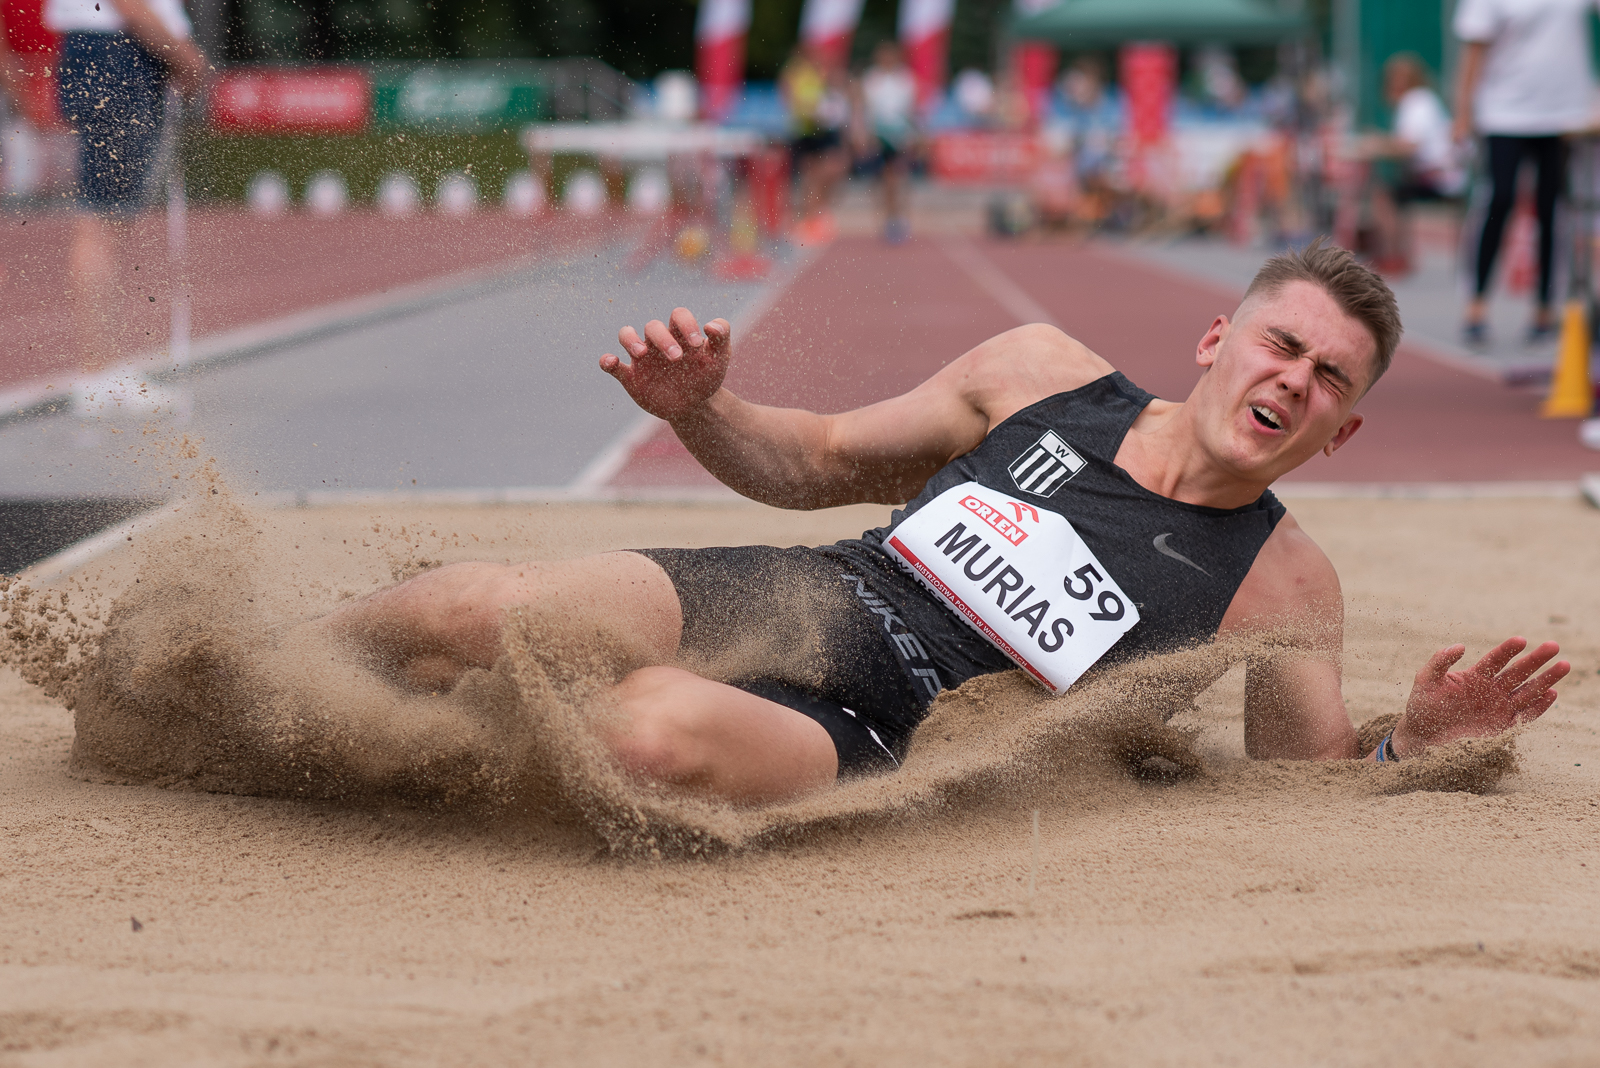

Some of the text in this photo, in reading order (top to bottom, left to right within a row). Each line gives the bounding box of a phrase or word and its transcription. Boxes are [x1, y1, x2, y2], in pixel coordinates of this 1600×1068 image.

[1055, 445, 1070, 458] W
[964, 498, 1024, 543] ORLEN
[914, 561, 955, 602] MISTRZOSTWA
[955, 600, 977, 622] POLSKI
[976, 619, 984, 627] W
[934, 522, 1075, 653] MURIAS
[1063, 563, 1126, 622] 59
[840, 573, 943, 706] NIKE P
